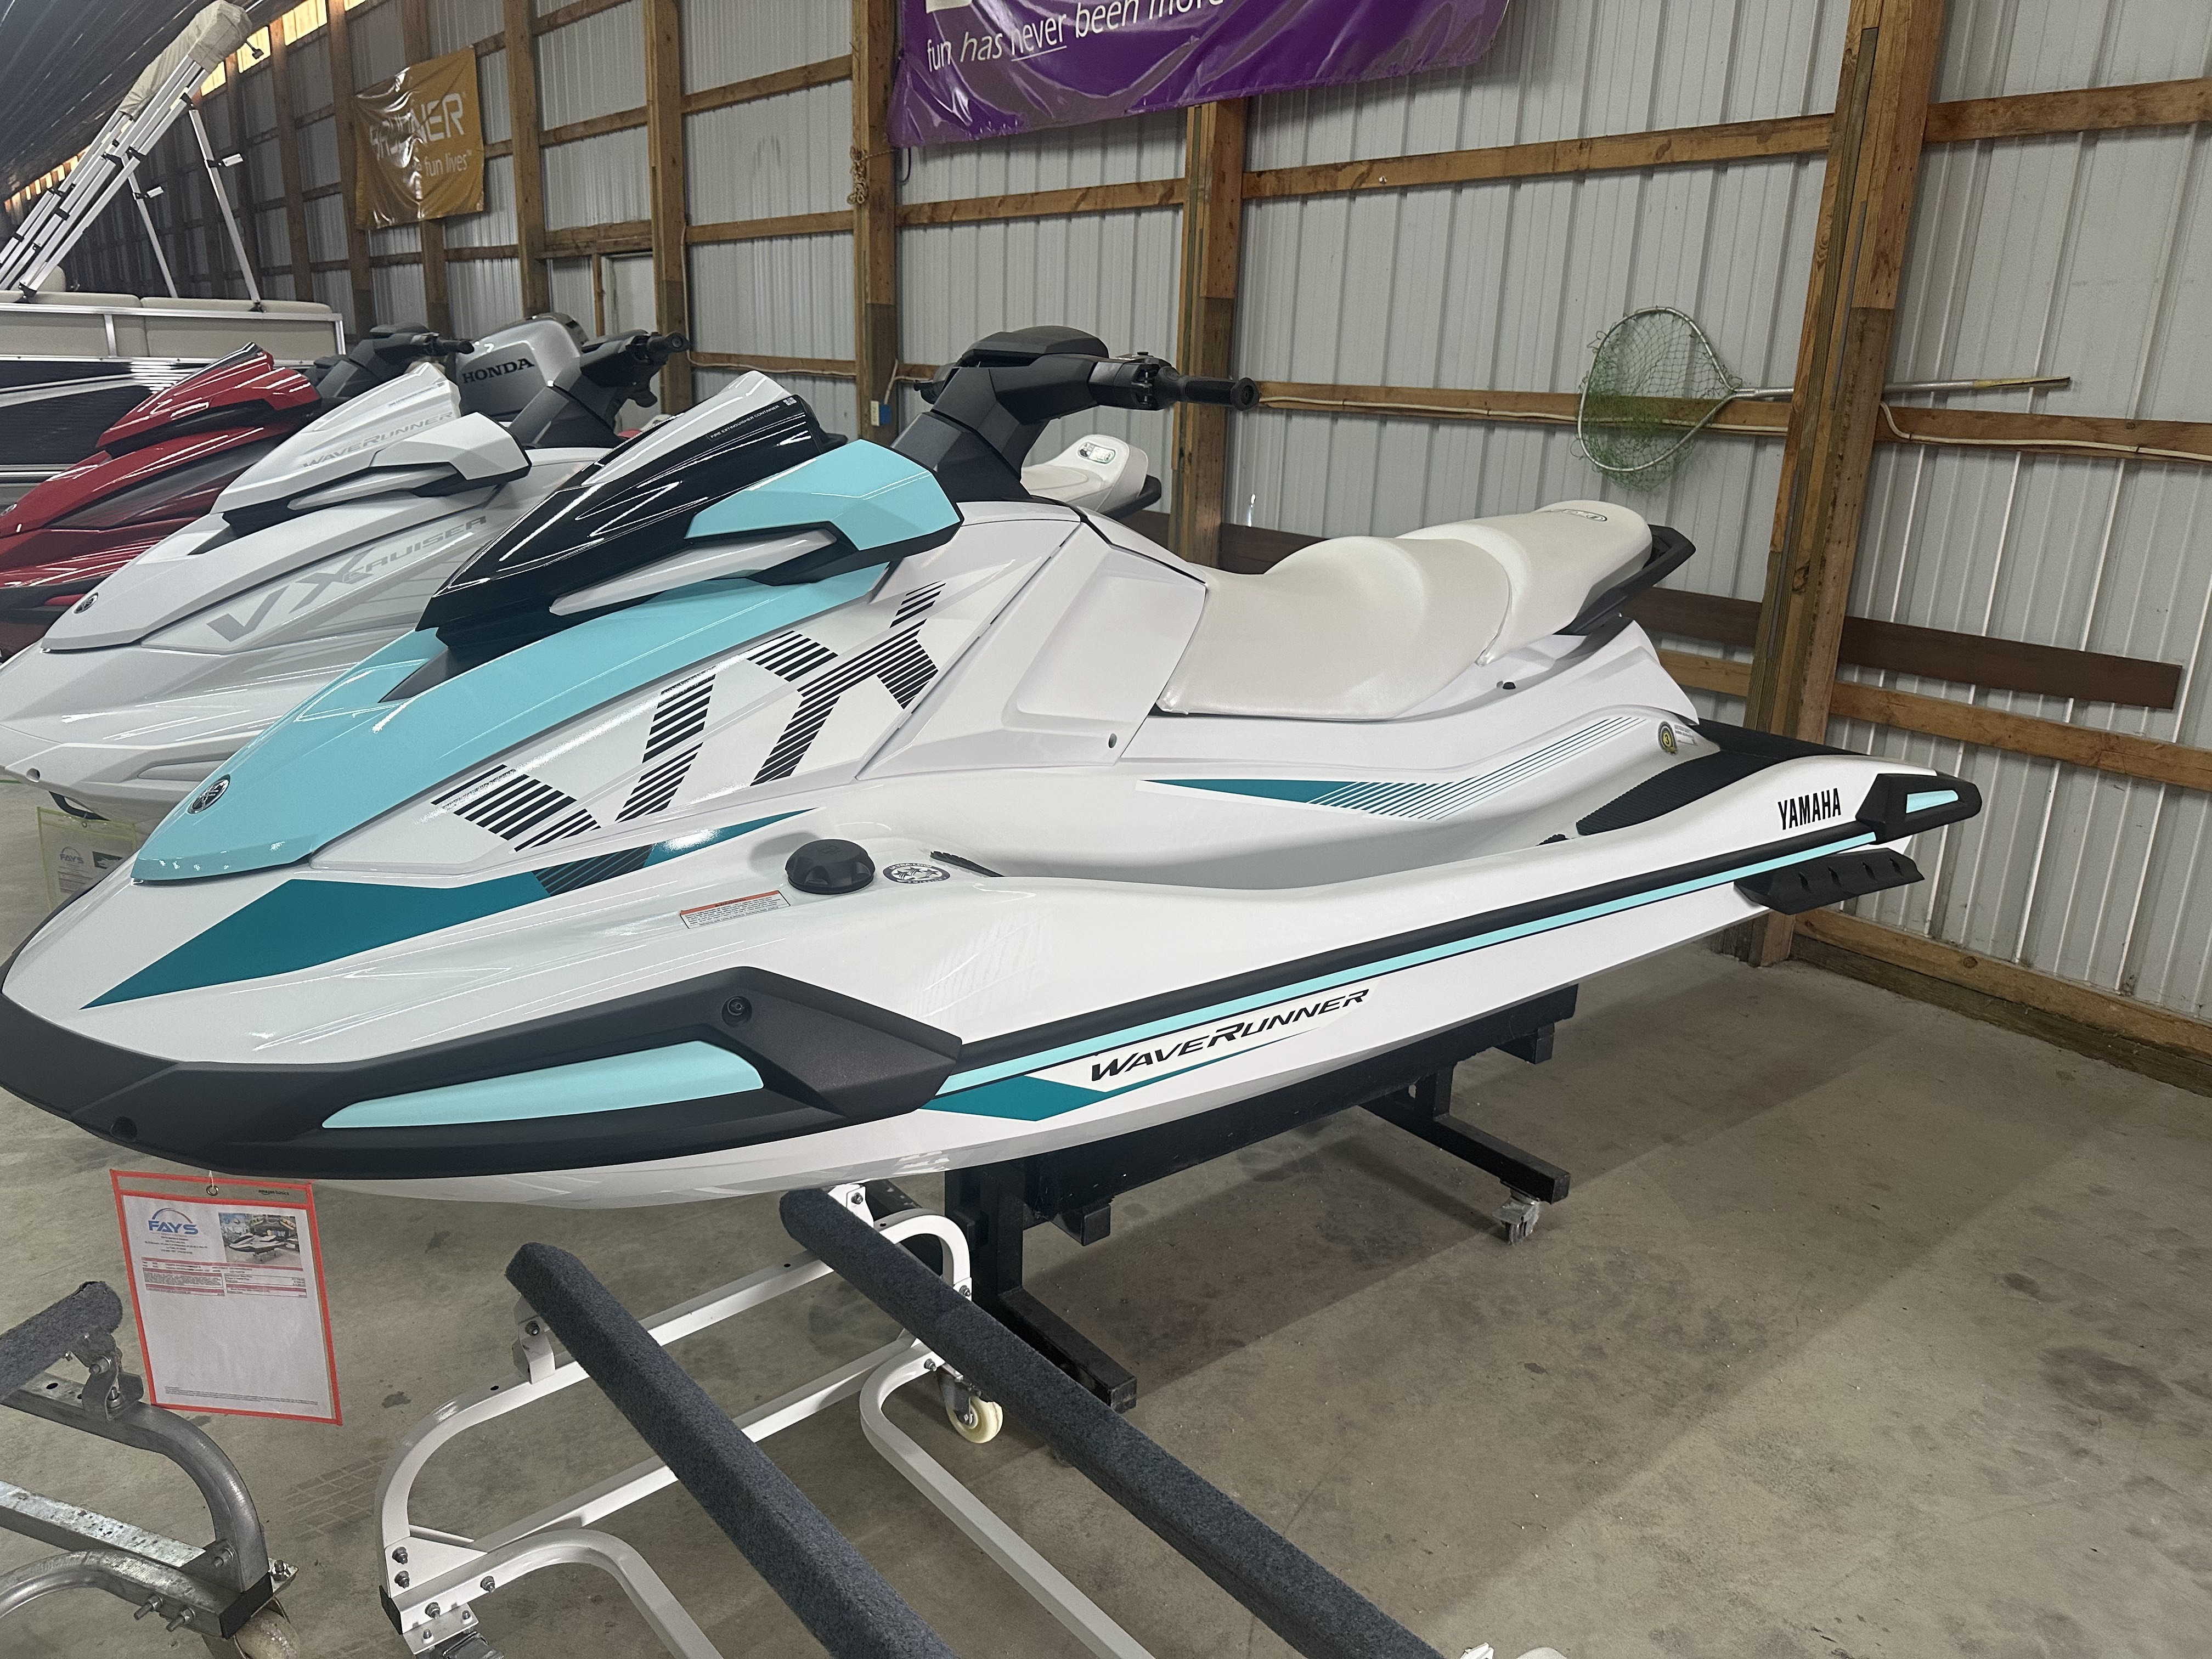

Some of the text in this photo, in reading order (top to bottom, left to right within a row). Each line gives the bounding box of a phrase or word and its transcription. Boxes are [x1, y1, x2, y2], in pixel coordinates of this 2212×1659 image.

[926, 0, 1224, 72] fun has never been mo
[424, 156, 443, 177] fun
[462, 357, 535, 383] HONDA
[722, 416, 754, 433] EXTINGUISHER
[754, 405, 780, 417] CONTAINER
[302, 411, 453, 469] WAVERUNNER
[206, 515, 487, 642] VX CRUISER
[1778, 787, 1842, 831] YAMAHA
[60, 854, 83, 864] FAYS
[1092, 989, 1370, 1082] WAVERUNNER
[148, 1220, 199, 1235] FAYS
